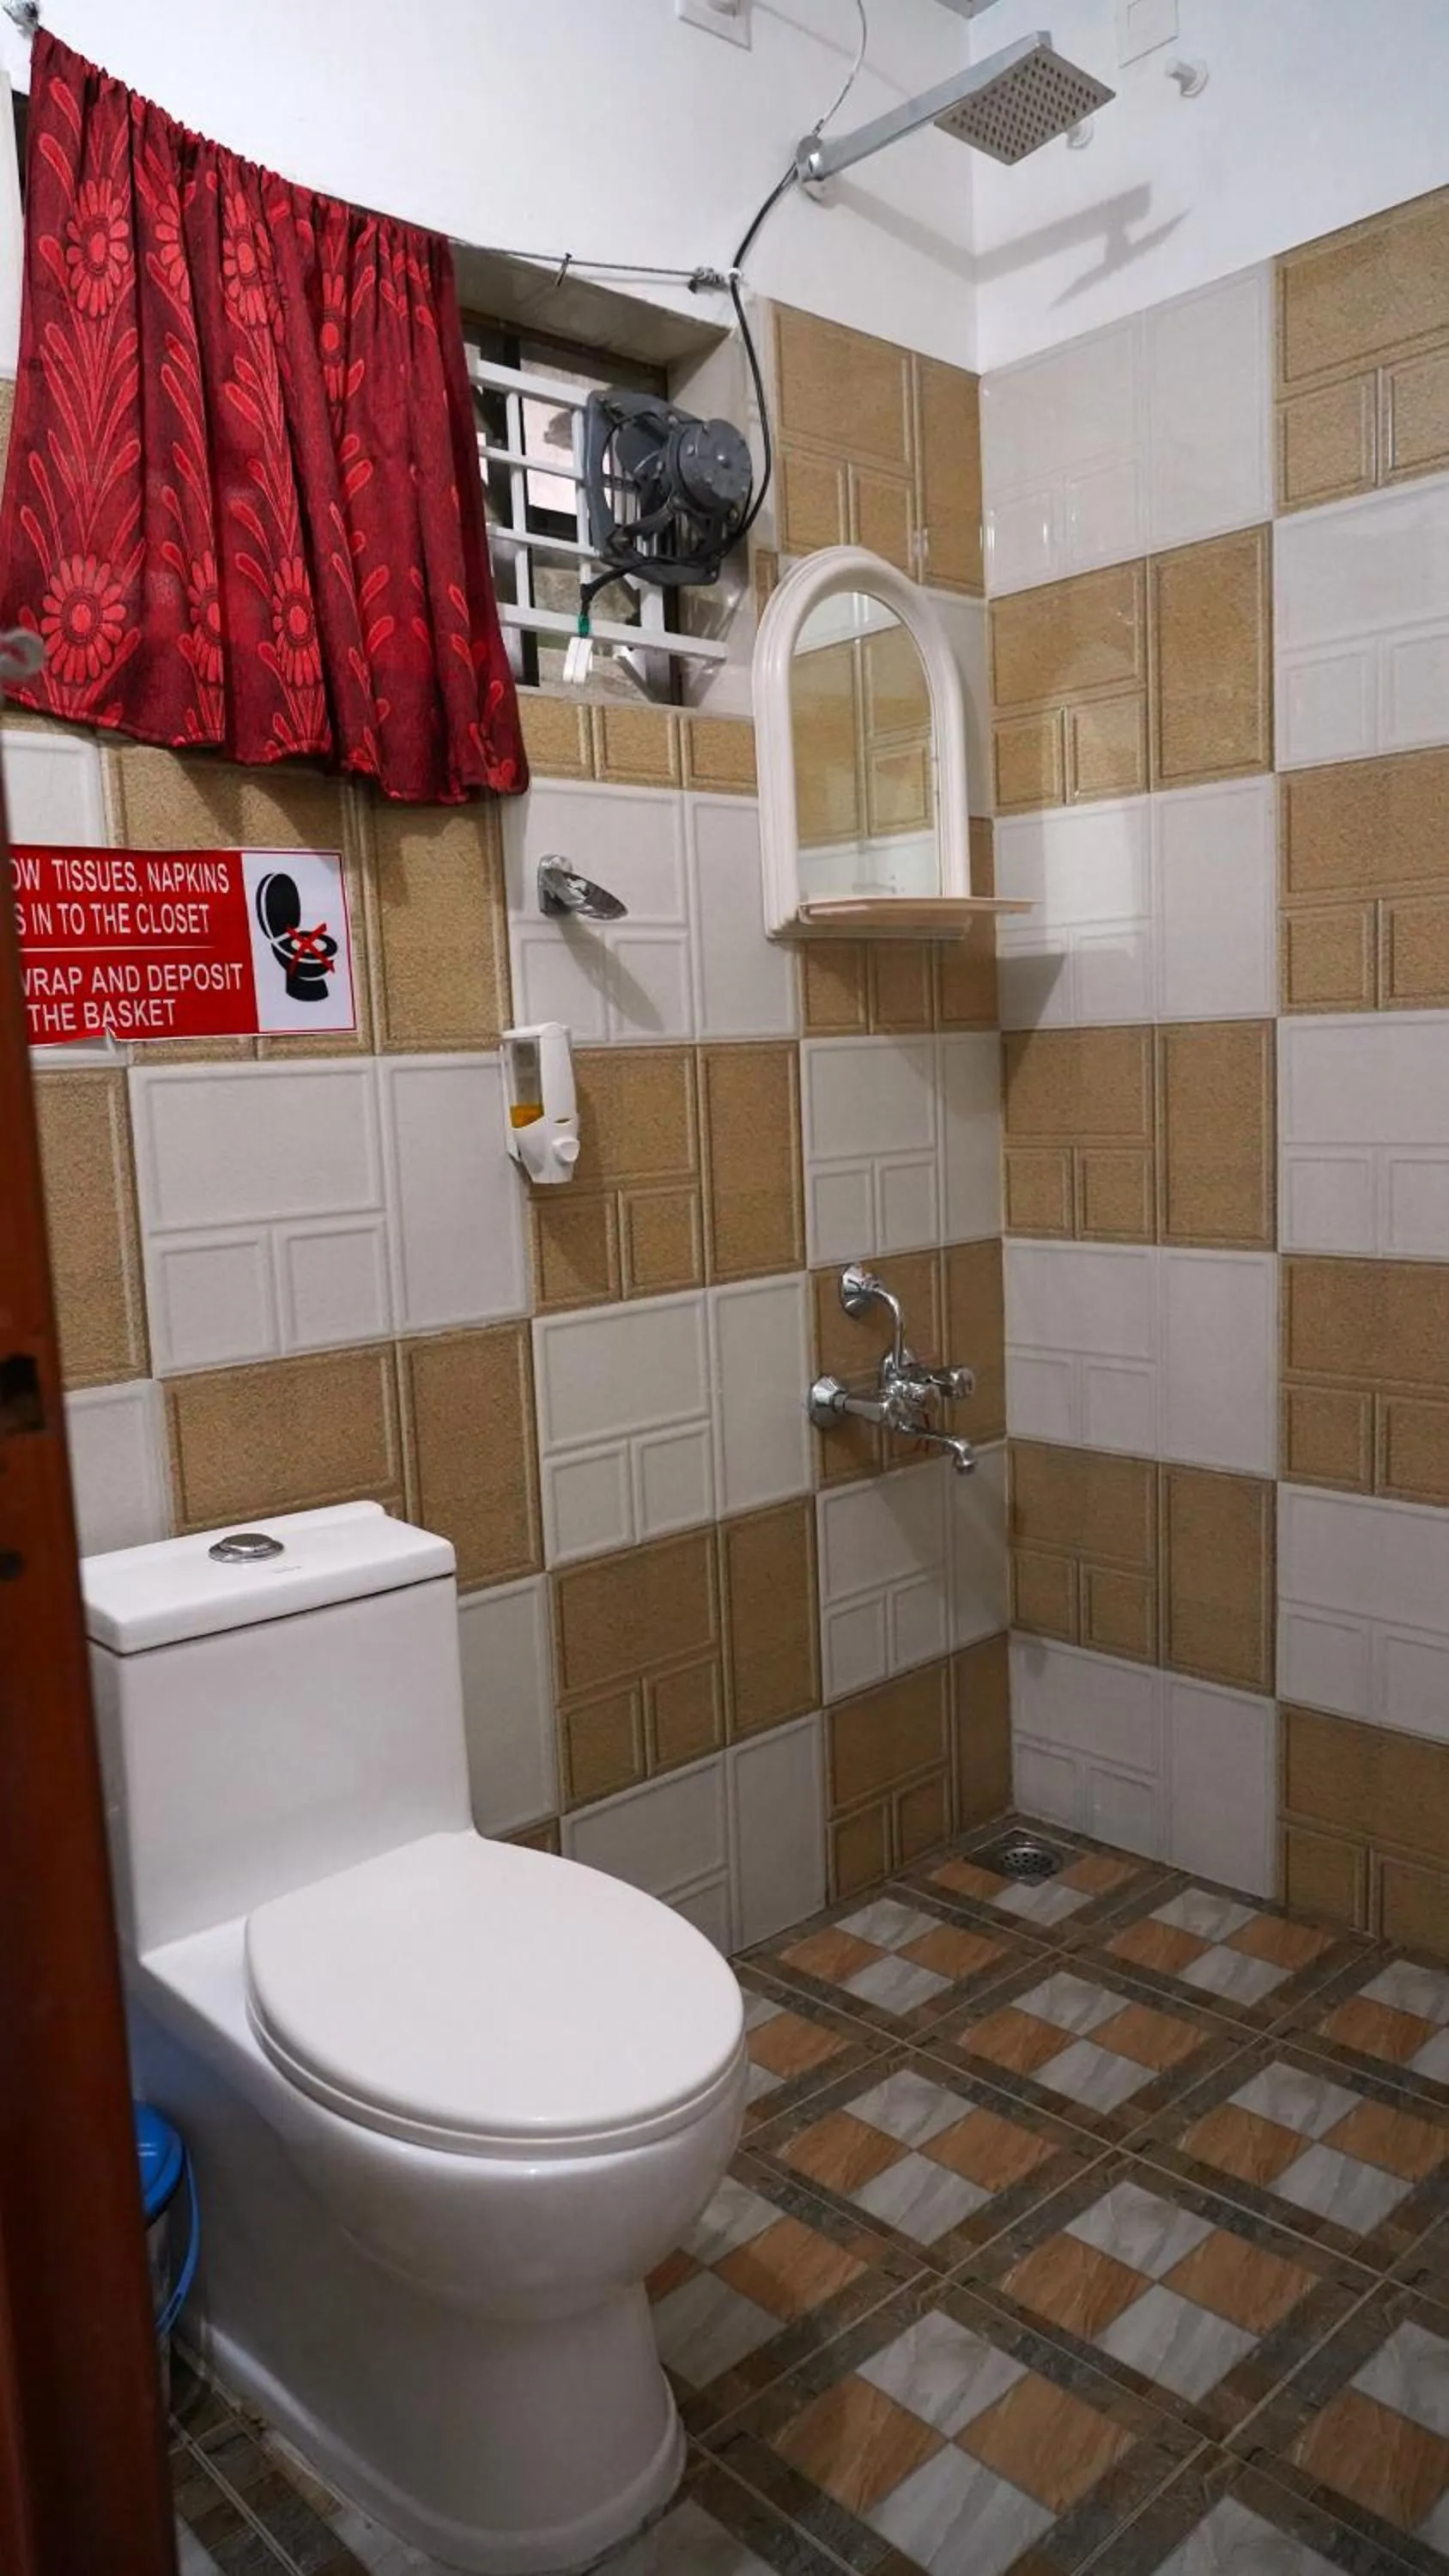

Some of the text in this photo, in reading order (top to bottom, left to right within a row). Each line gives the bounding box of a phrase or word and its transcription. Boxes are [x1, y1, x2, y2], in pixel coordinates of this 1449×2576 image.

[52, 859, 143, 897] TISSUES,
[147, 861, 229, 894] NAPKINS
[31, 902, 53, 935] IN
[56, 902, 85, 935] TO
[89, 902, 131, 934] THE
[136, 902, 209, 934] CLOSET
[91, 964, 141, 993] AND
[147, 963, 243, 992] DEPOSIT
[27, 999, 176, 1032] THE BASKET
